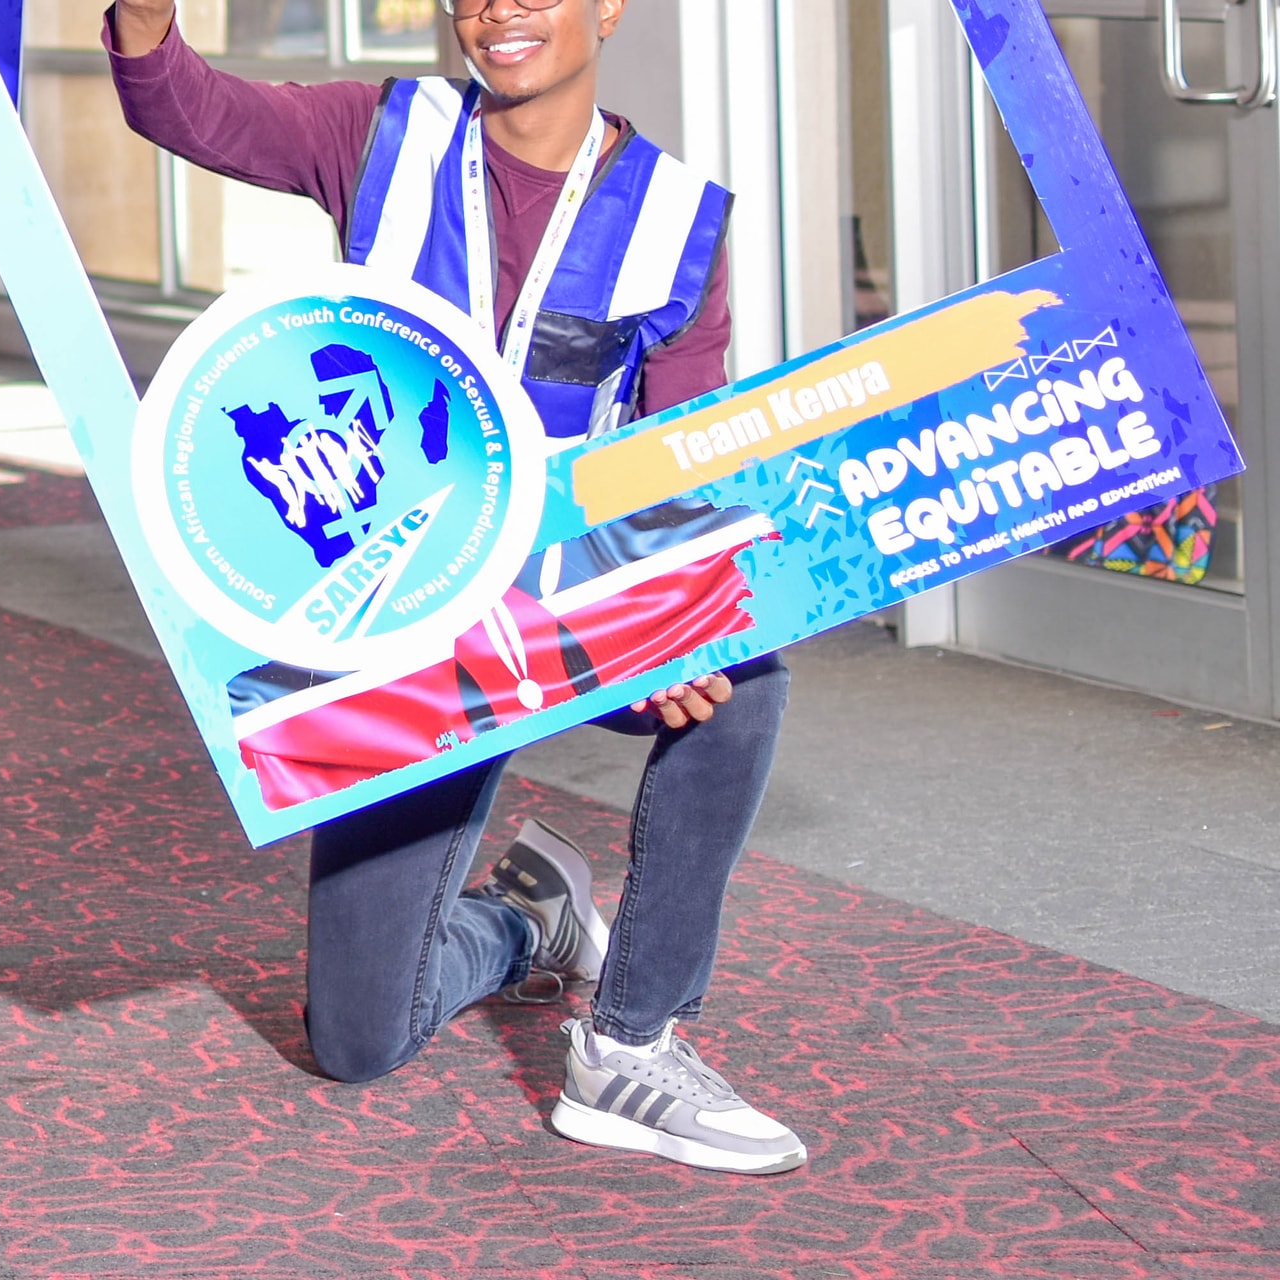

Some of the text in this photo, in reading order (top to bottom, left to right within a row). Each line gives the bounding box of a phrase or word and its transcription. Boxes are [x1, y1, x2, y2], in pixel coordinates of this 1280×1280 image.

[173, 307, 503, 615] Southern African Regional Students & Youth Conference on Sexual & Reproductive Health
[663, 360, 891, 471] Team Kenya
[305, 508, 429, 635] SARSYC
[890, 557, 939, 587] ACCESS
[940, 550, 960, 568] TO
[1014, 508, 1066, 542] HEALTH
[1068, 497, 1100, 520] AND
